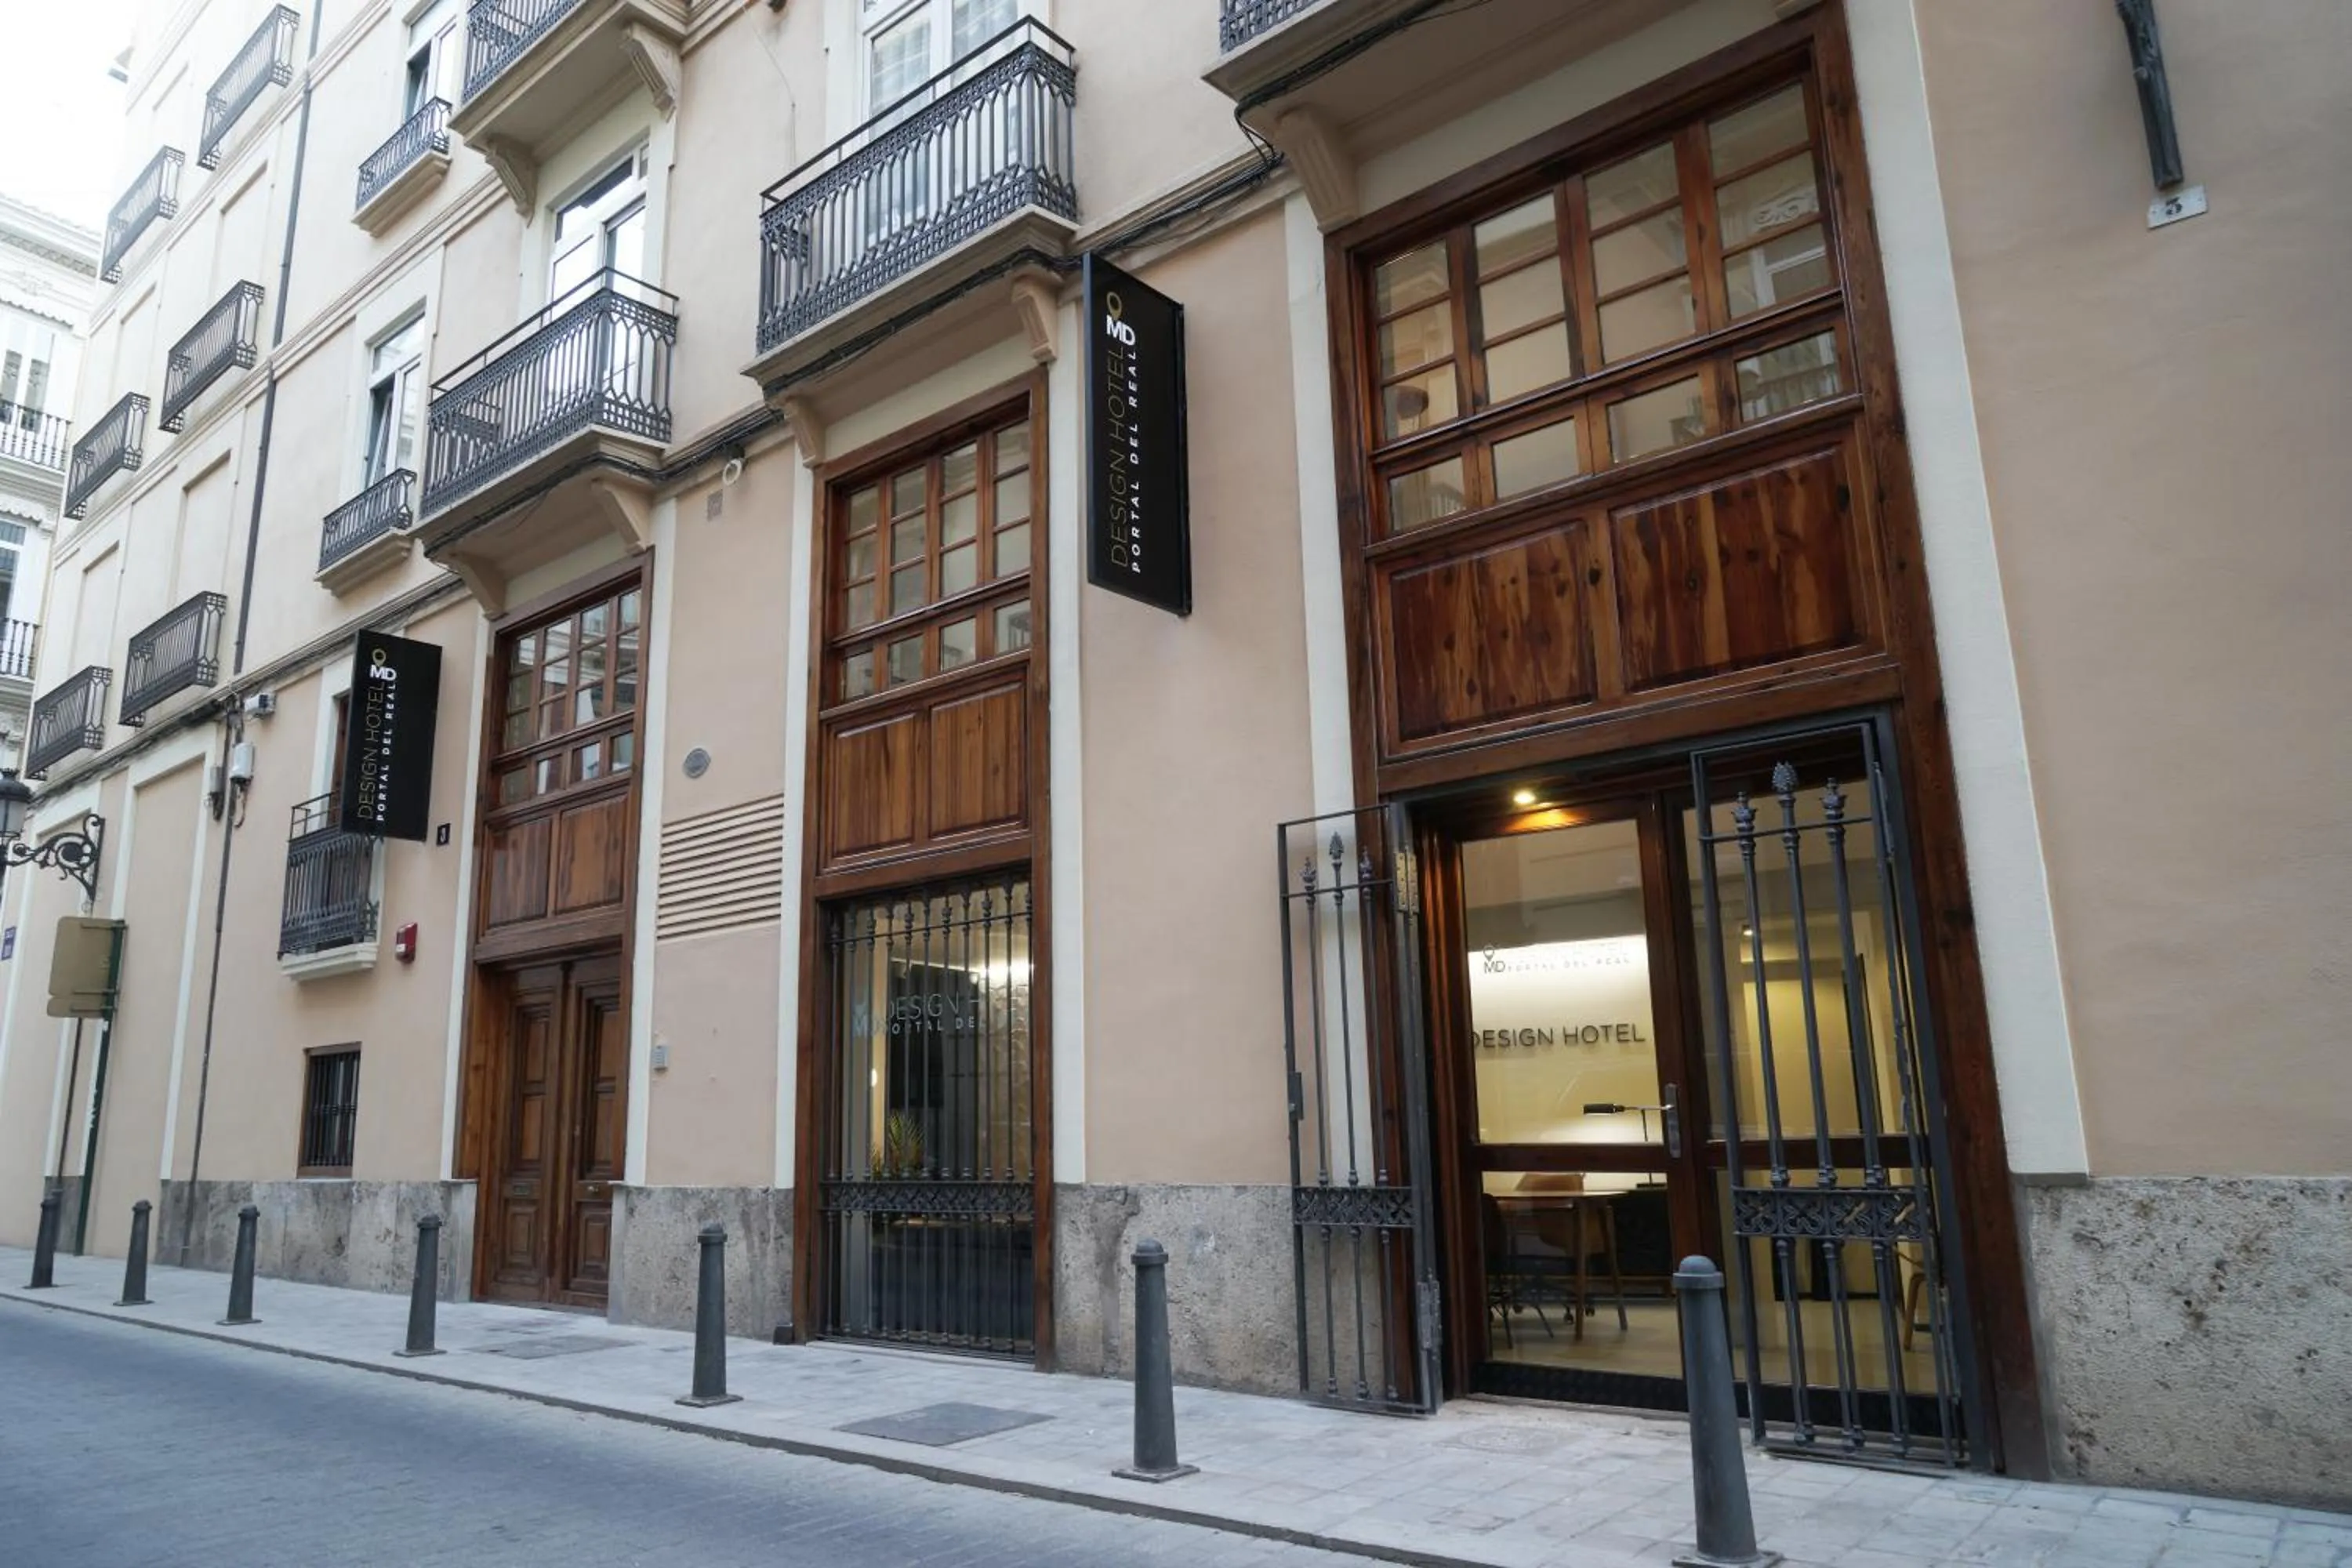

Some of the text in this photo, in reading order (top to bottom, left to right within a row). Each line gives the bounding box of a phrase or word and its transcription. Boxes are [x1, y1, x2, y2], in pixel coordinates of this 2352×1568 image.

[1106, 314, 1136, 346] MD
[1108, 346, 1128, 567] DESIGN HOTEL
[1127, 350, 1141, 573] PORTAL DEL REAL
[369, 665, 397, 681] MD
[358, 681, 384, 820] DESIGN HOTEL
[376, 683, 396, 822] PORTAL DEL REAL
[1484, 960, 1506, 974] MD
[1563, 1023, 1646, 1046] HOTEL
